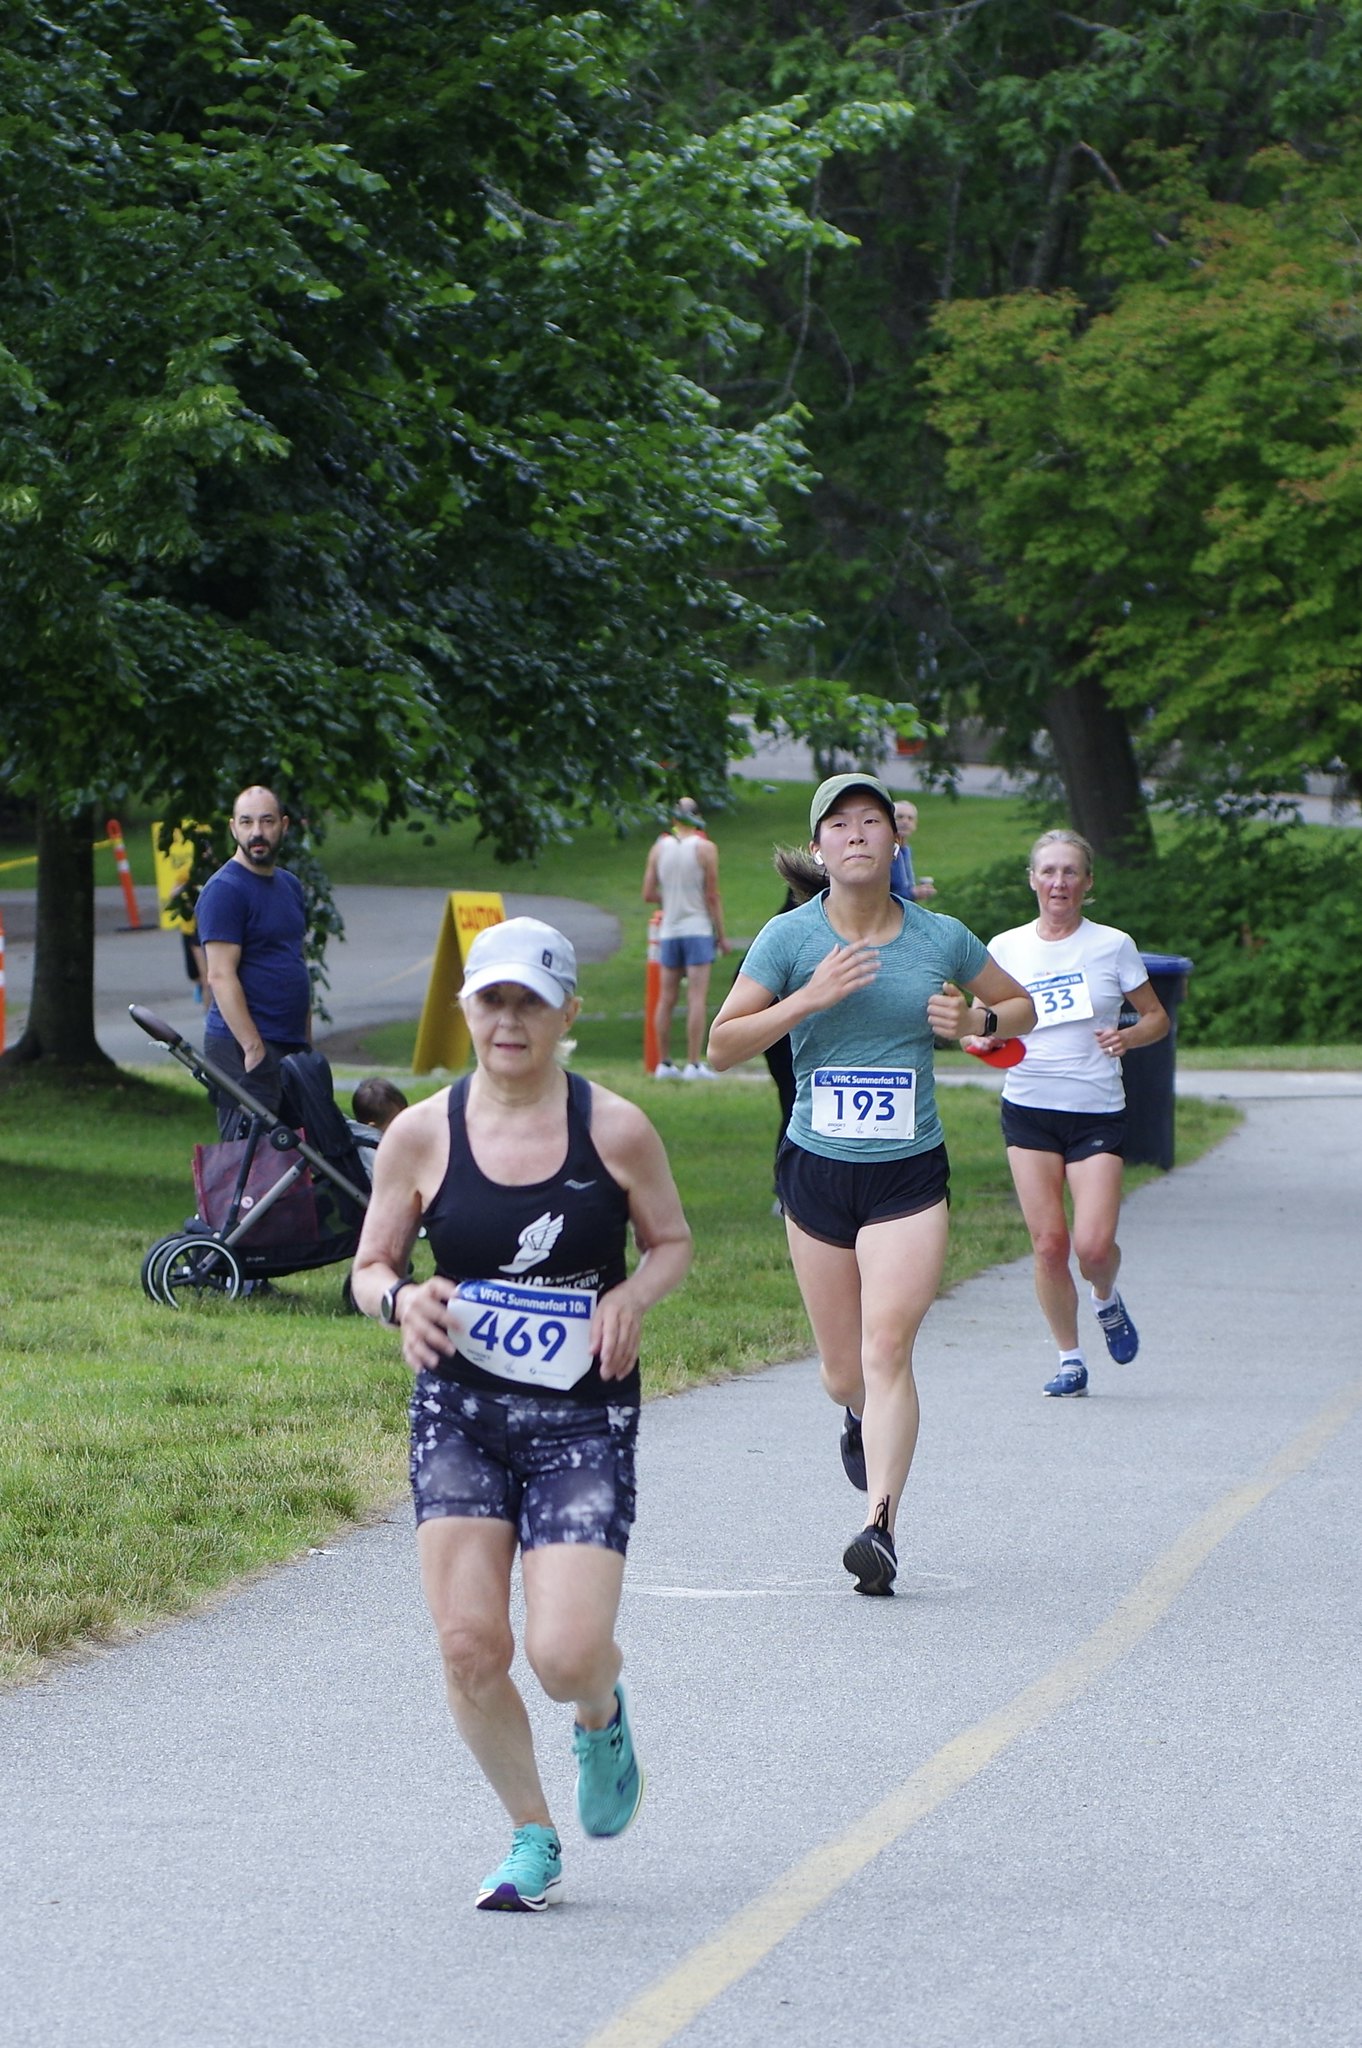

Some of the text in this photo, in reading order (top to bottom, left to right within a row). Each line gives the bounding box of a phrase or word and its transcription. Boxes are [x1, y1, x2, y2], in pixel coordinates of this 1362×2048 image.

[832, 1074, 851, 1085] VFAC
[833, 1089, 895, 1121] 193
[574, 1273, 599, 1289] CREW
[480, 1286, 507, 1304] VFAC
[507, 1293, 567, 1313] Summerfast
[469, 1310, 567, 1362] 469
